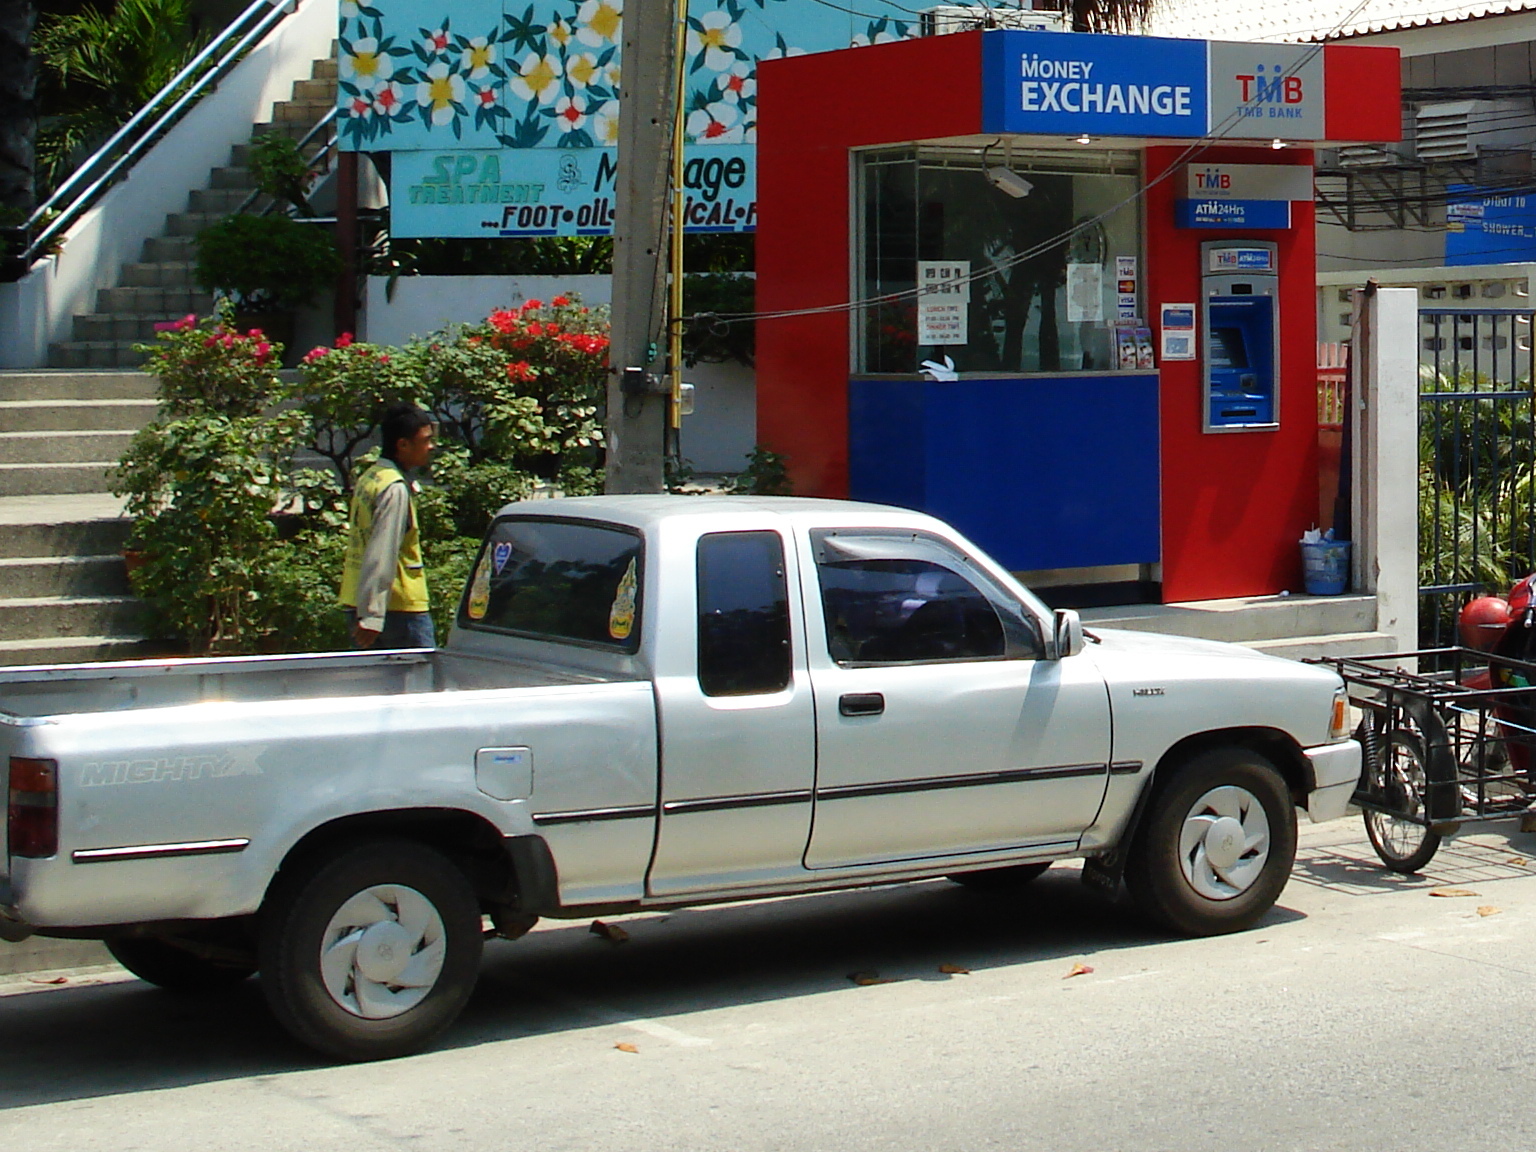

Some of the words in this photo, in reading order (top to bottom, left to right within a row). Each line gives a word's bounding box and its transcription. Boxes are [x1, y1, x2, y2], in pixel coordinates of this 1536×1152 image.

[1021, 54, 1094, 79] MONEY
[1236, 63, 1303, 104] TMB
[1021, 82, 1192, 116] EXCHANGE
[1236, 106, 1263, 118] TMB
[1268, 107, 1303, 119] BANK
[422, 154, 501, 185] SPA
[594, 152, 746, 201] Mage
[1195, 168, 1231, 189] TMB
[408, 183, 545, 204] TREATMENT
